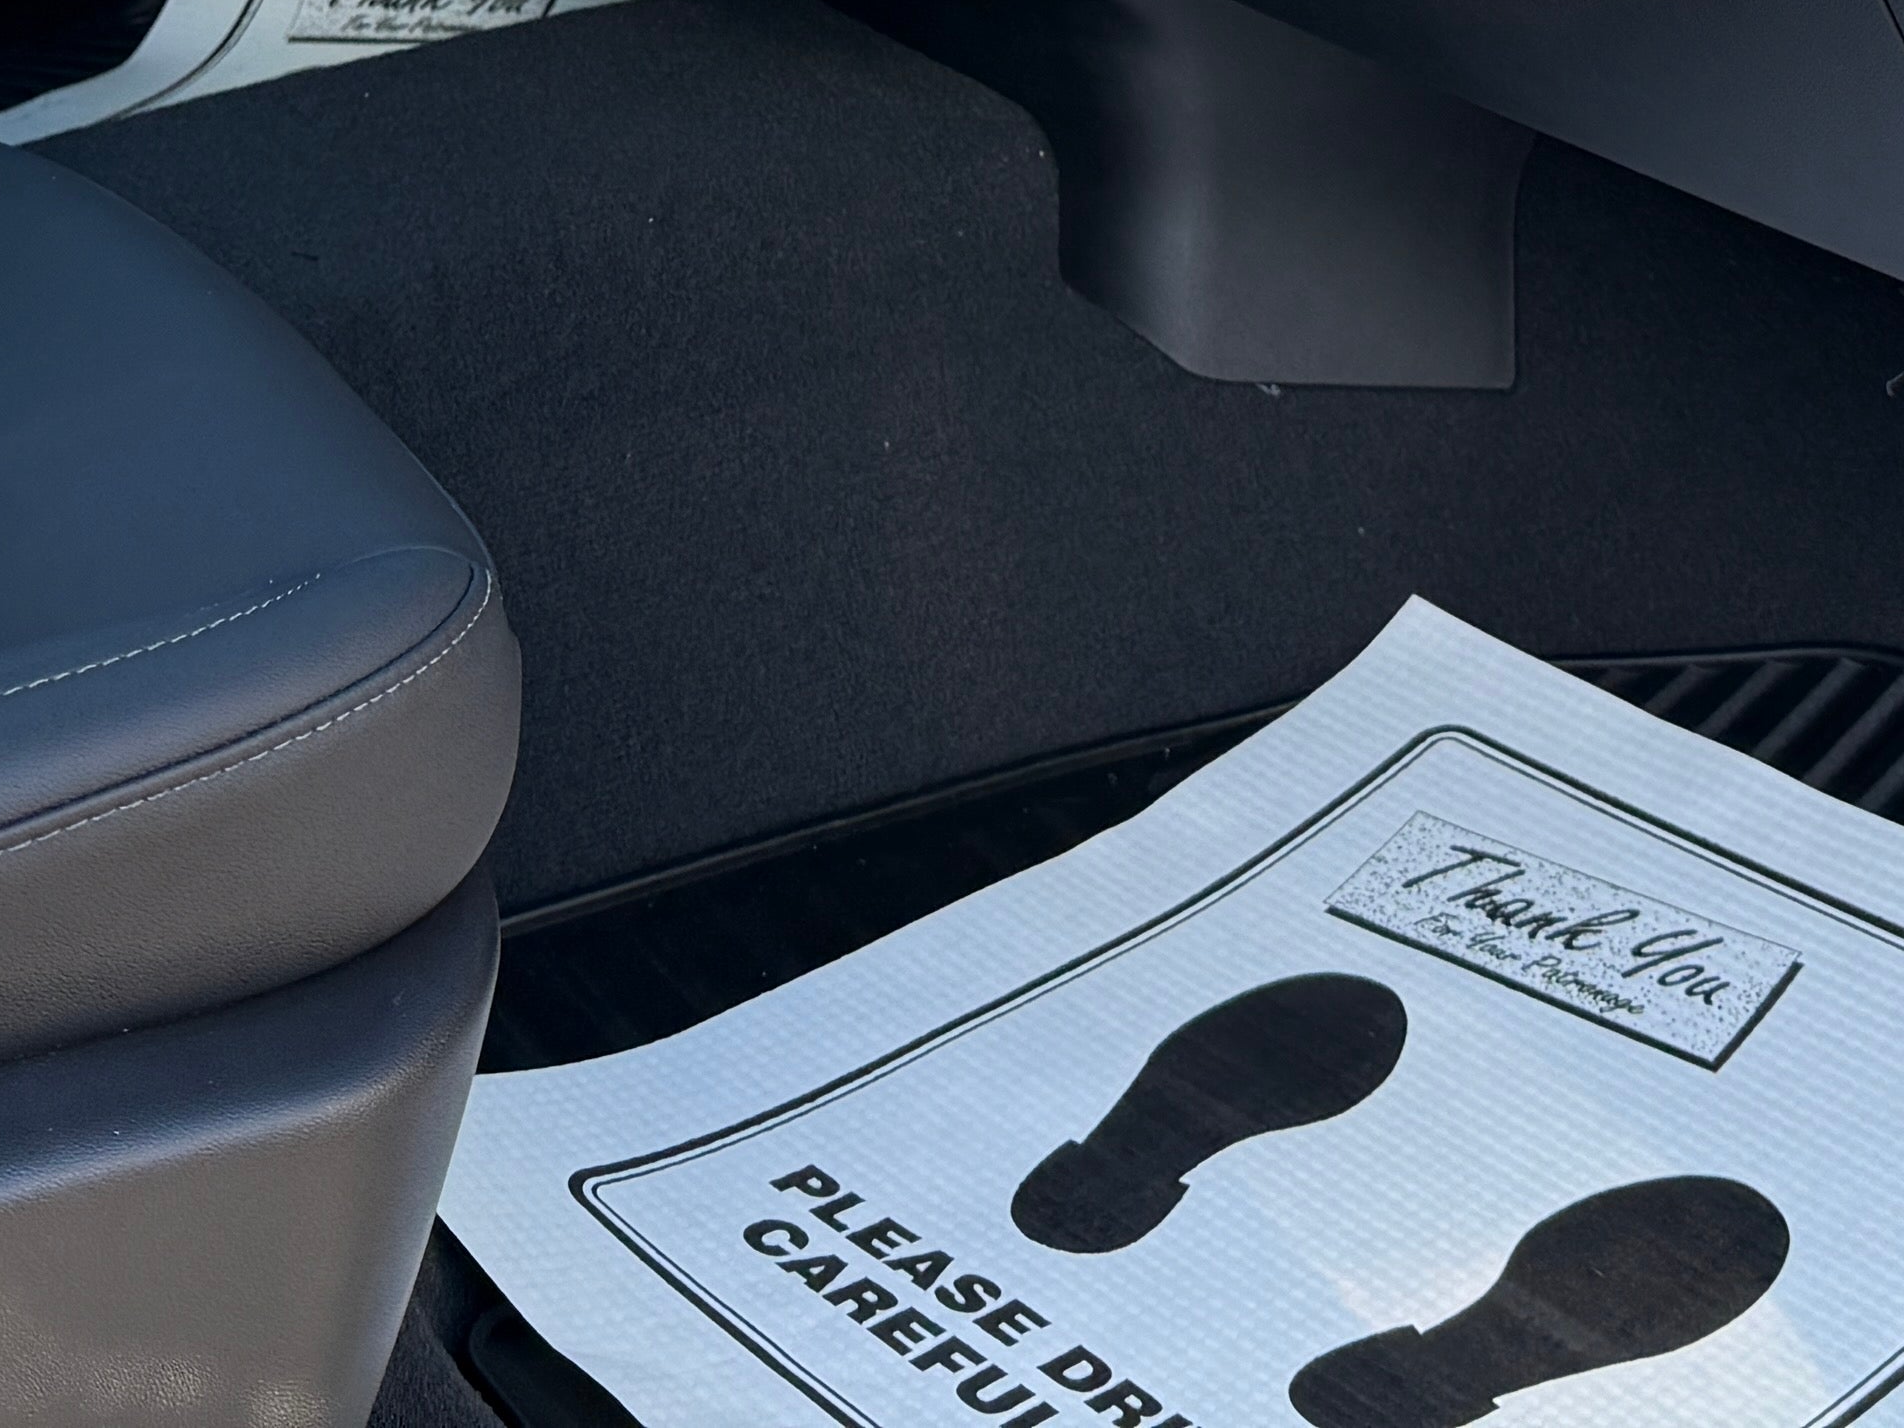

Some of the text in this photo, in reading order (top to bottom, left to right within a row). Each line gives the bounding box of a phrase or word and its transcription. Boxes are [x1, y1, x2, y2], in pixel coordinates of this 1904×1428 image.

[1401, 845, 1730, 1006] Thank You
[1414, 911, 1645, 1016] For Your Patronage
[769, 1164, 1052, 1347] PLEASE
